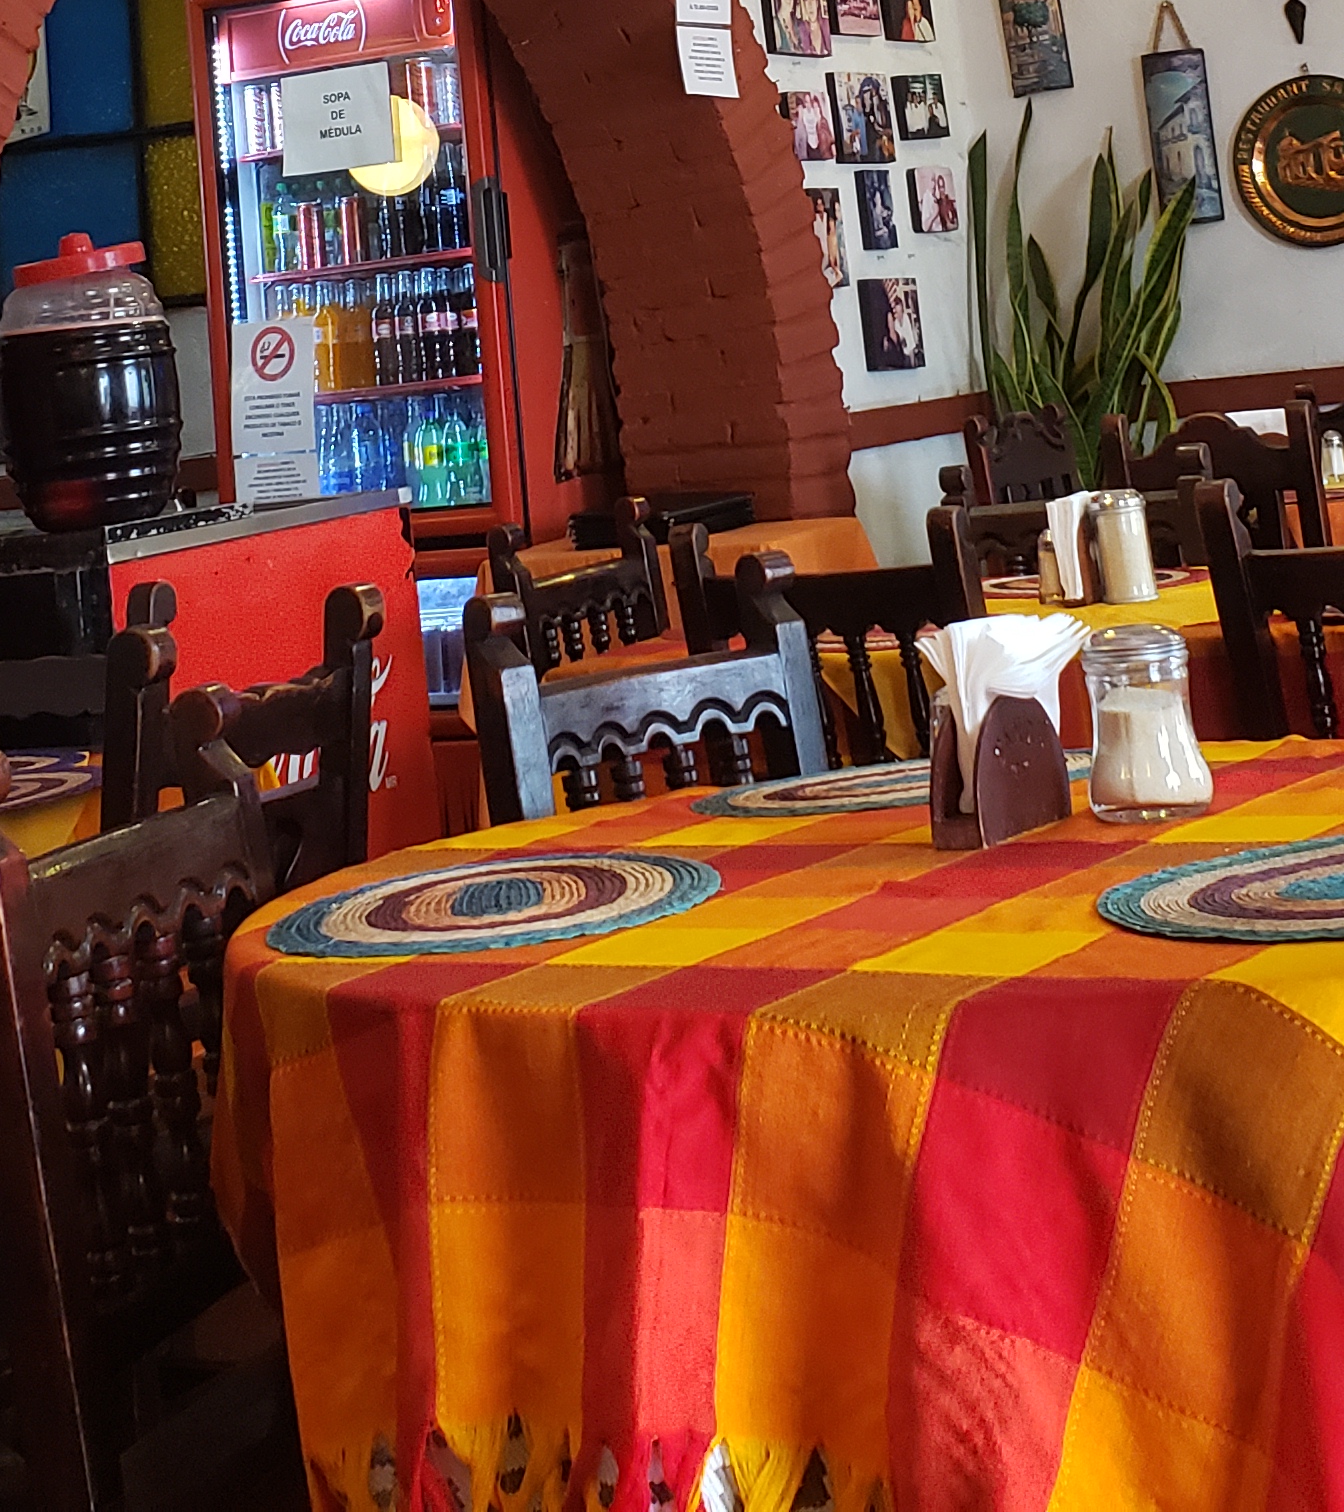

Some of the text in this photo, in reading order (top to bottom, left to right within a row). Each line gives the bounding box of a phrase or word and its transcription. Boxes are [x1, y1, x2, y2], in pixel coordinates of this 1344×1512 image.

[284, 9, 359, 50] Coca-Cola
[322, 91, 351, 104] SOPA
[330, 109, 346, 120] DE
